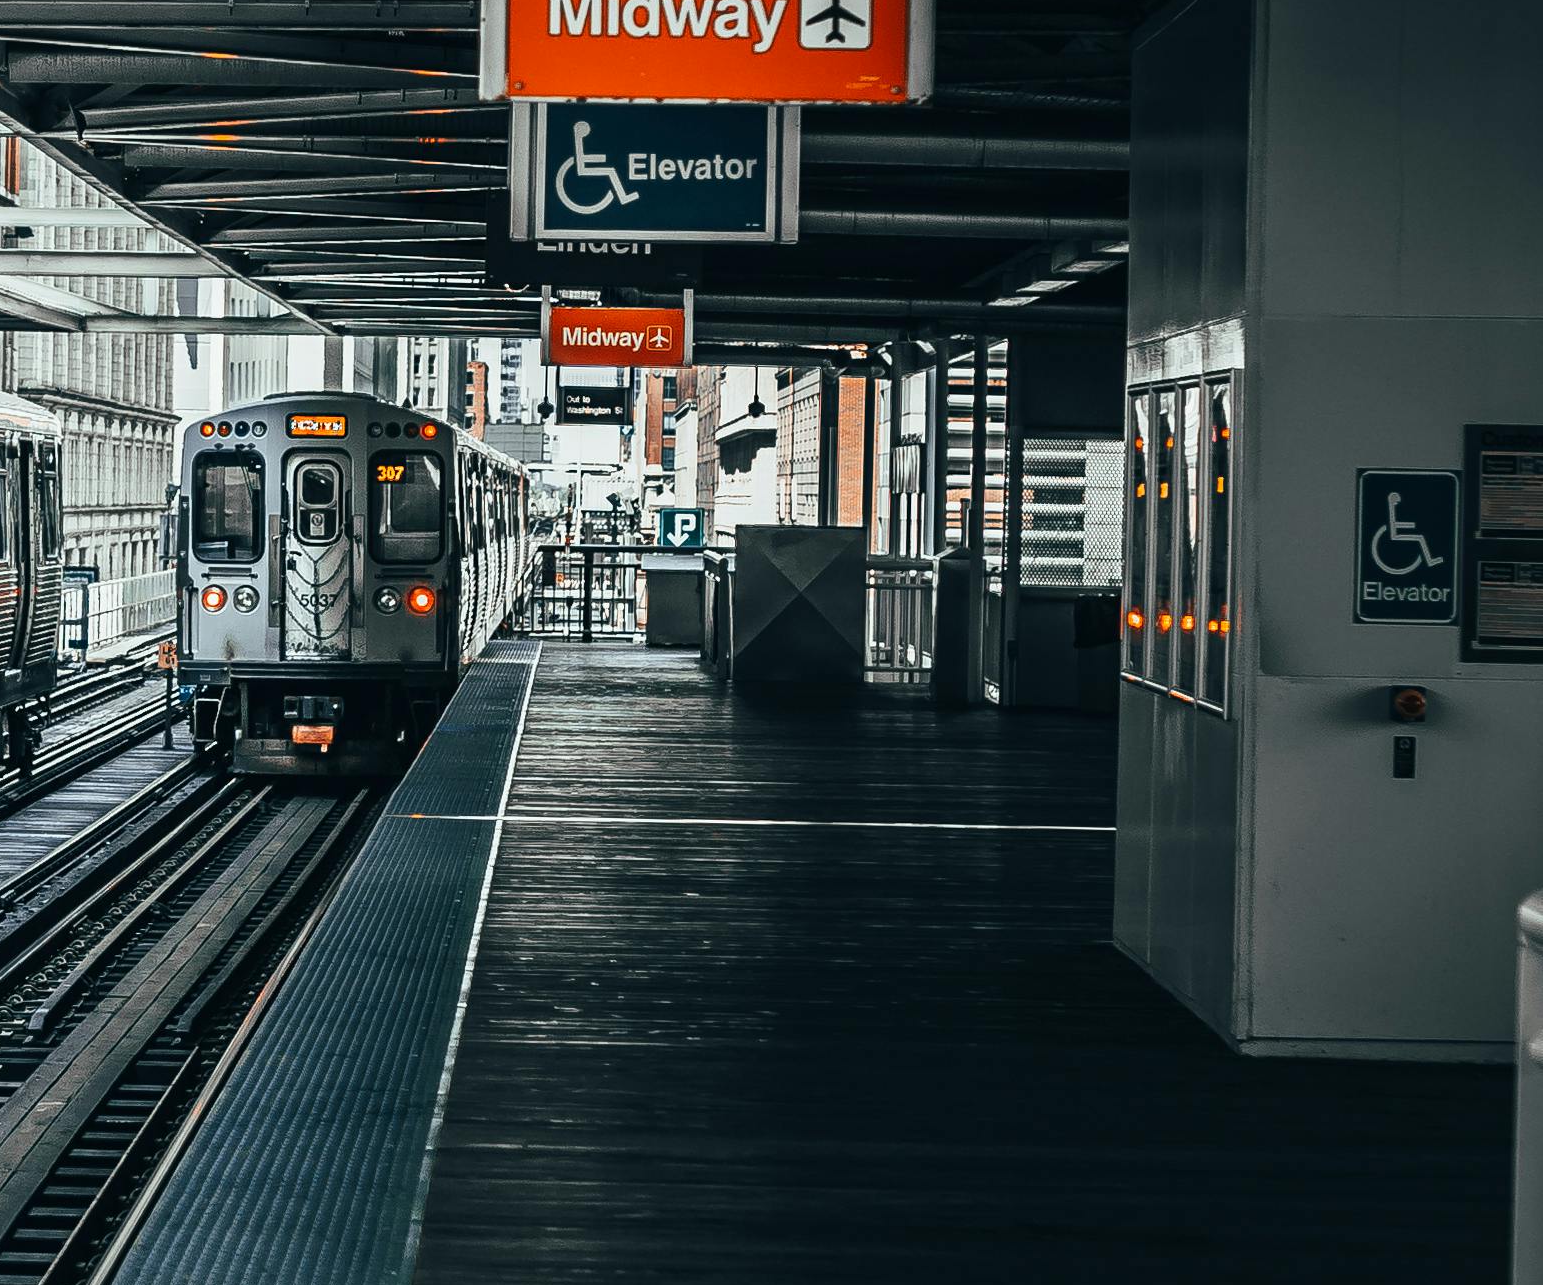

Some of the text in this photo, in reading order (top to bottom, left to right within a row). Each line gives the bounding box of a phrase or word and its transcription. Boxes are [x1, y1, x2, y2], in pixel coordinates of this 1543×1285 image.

[628, 153, 757, 180] Elevator
[562, 326, 645, 352] Midway
[566, 395, 591, 404] Out to
[566, 406, 611, 416] Washington
[376, 465, 405, 482] 307
[300, 593, 338, 607] 5037
[1363, 581, 1451, 602] Elevator
